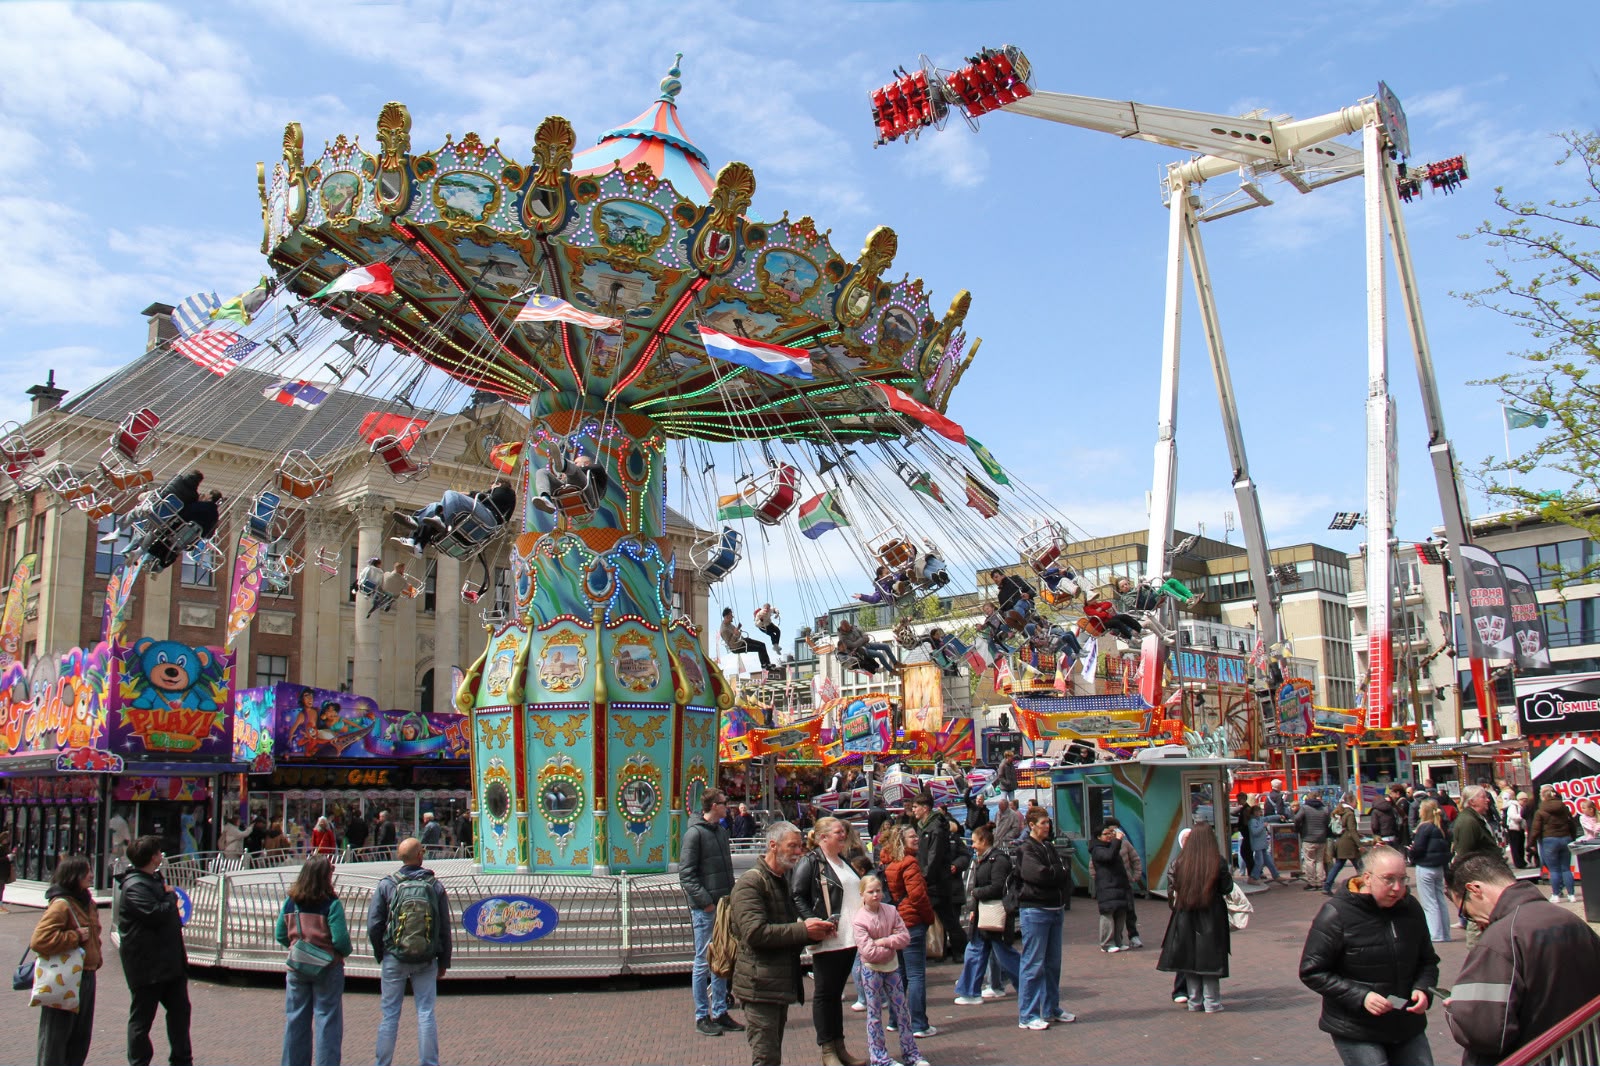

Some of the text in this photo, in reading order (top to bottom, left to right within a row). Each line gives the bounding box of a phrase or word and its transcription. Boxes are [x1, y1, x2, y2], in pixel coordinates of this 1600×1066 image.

[6, 676, 74, 751] Teddy
[126, 708, 217, 739] PLAY!
[151, 732, 197, 749] Winner
[1553, 776, 1600, 799] HOT
[477, 906, 497, 925] El
